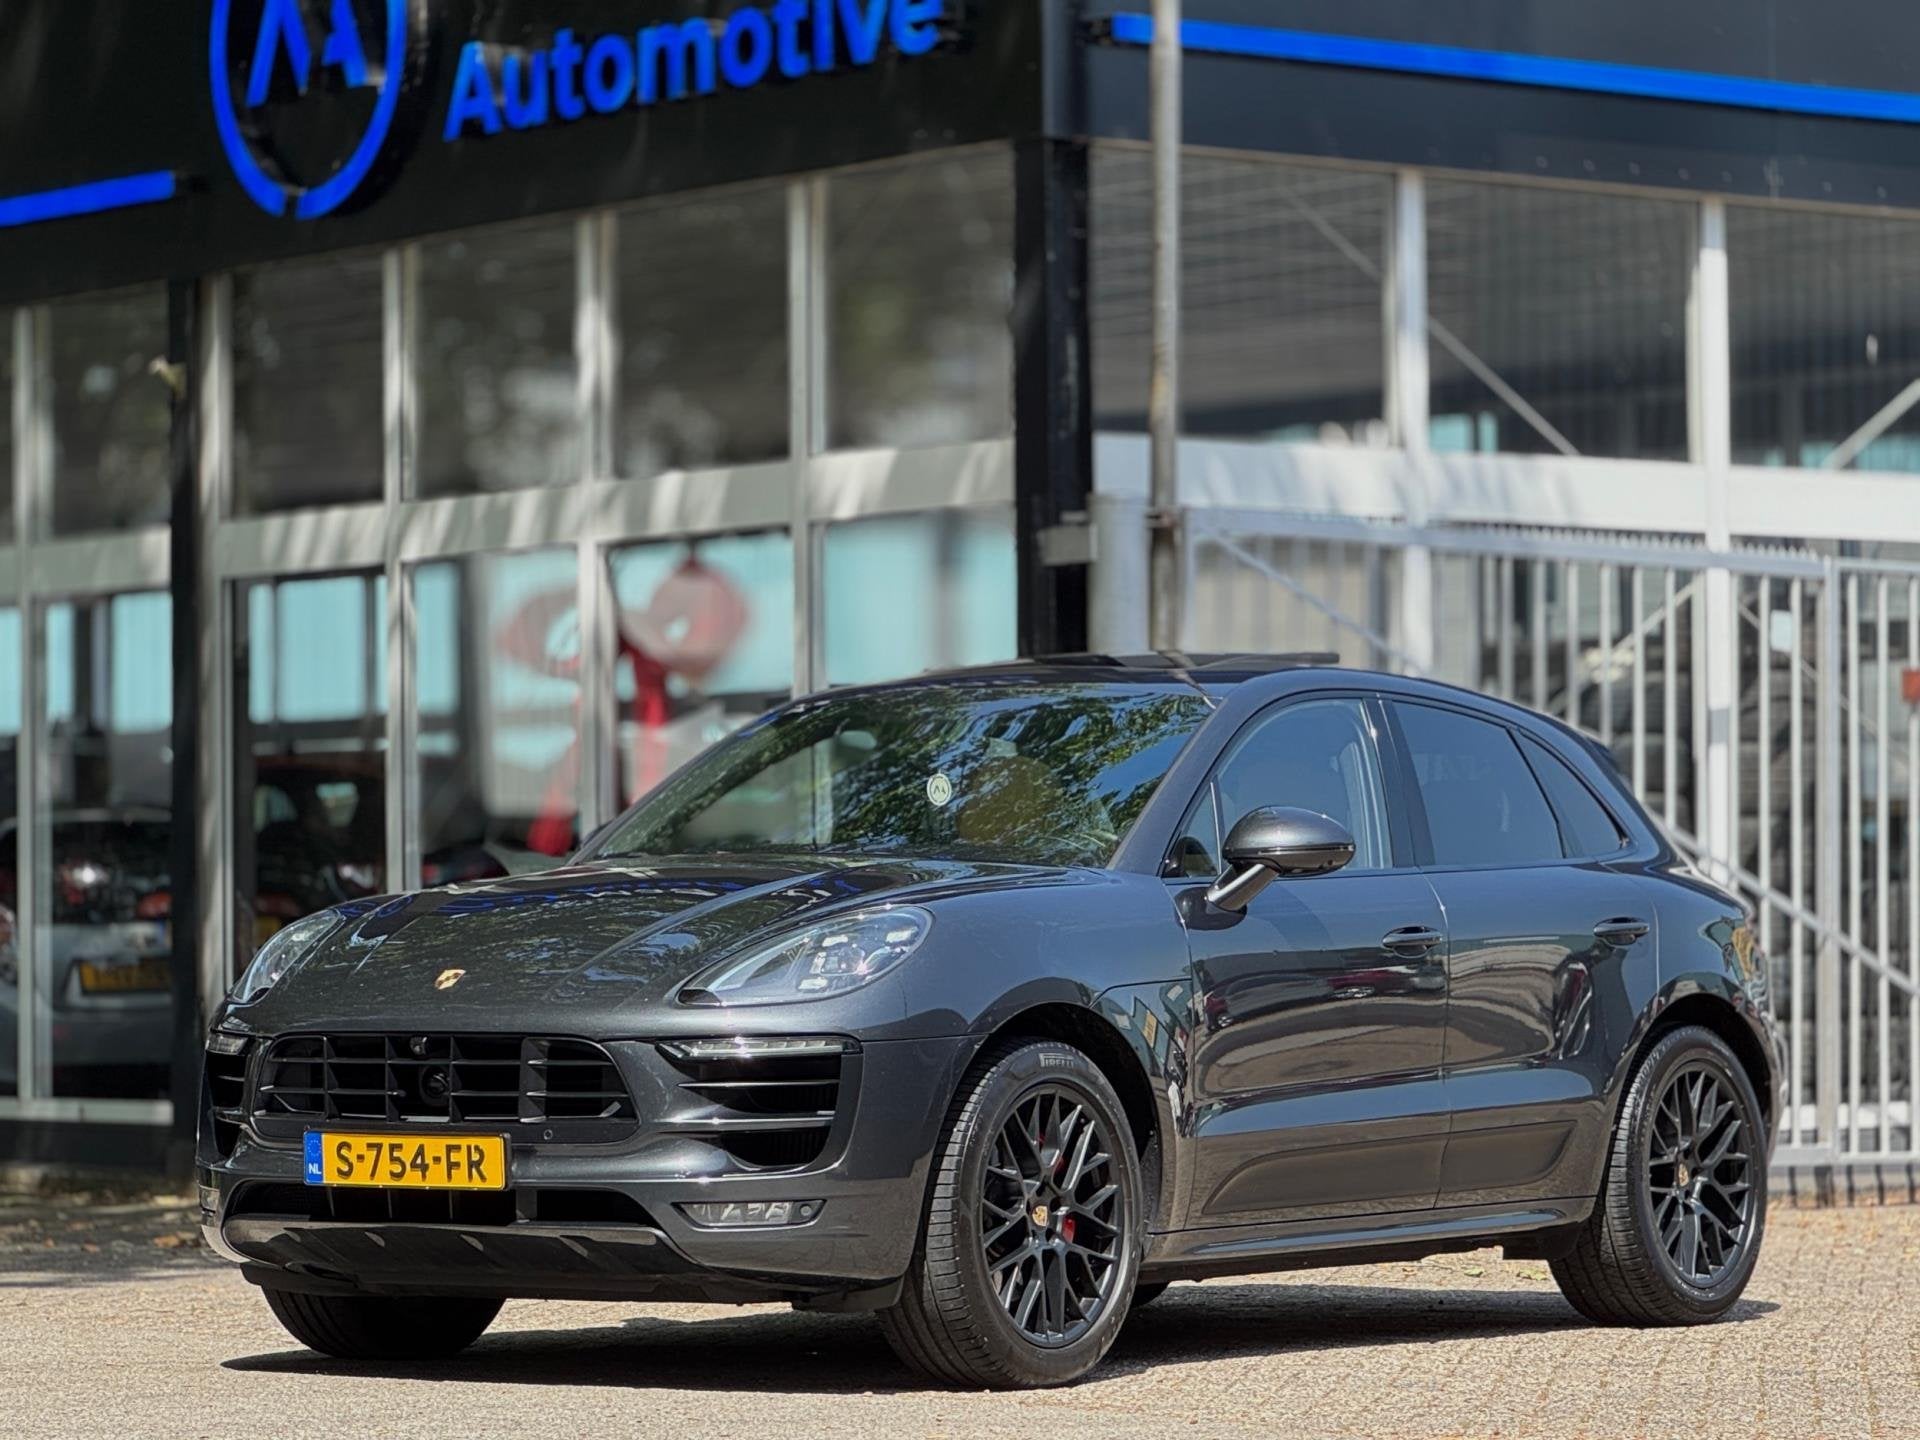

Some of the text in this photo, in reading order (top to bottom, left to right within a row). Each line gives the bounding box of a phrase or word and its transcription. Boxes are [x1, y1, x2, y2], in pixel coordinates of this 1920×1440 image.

[443, 0, 943, 141] Automotive
[308, 1163, 322, 1175] NL
[336, 1141, 487, 1183] S-754-FR
